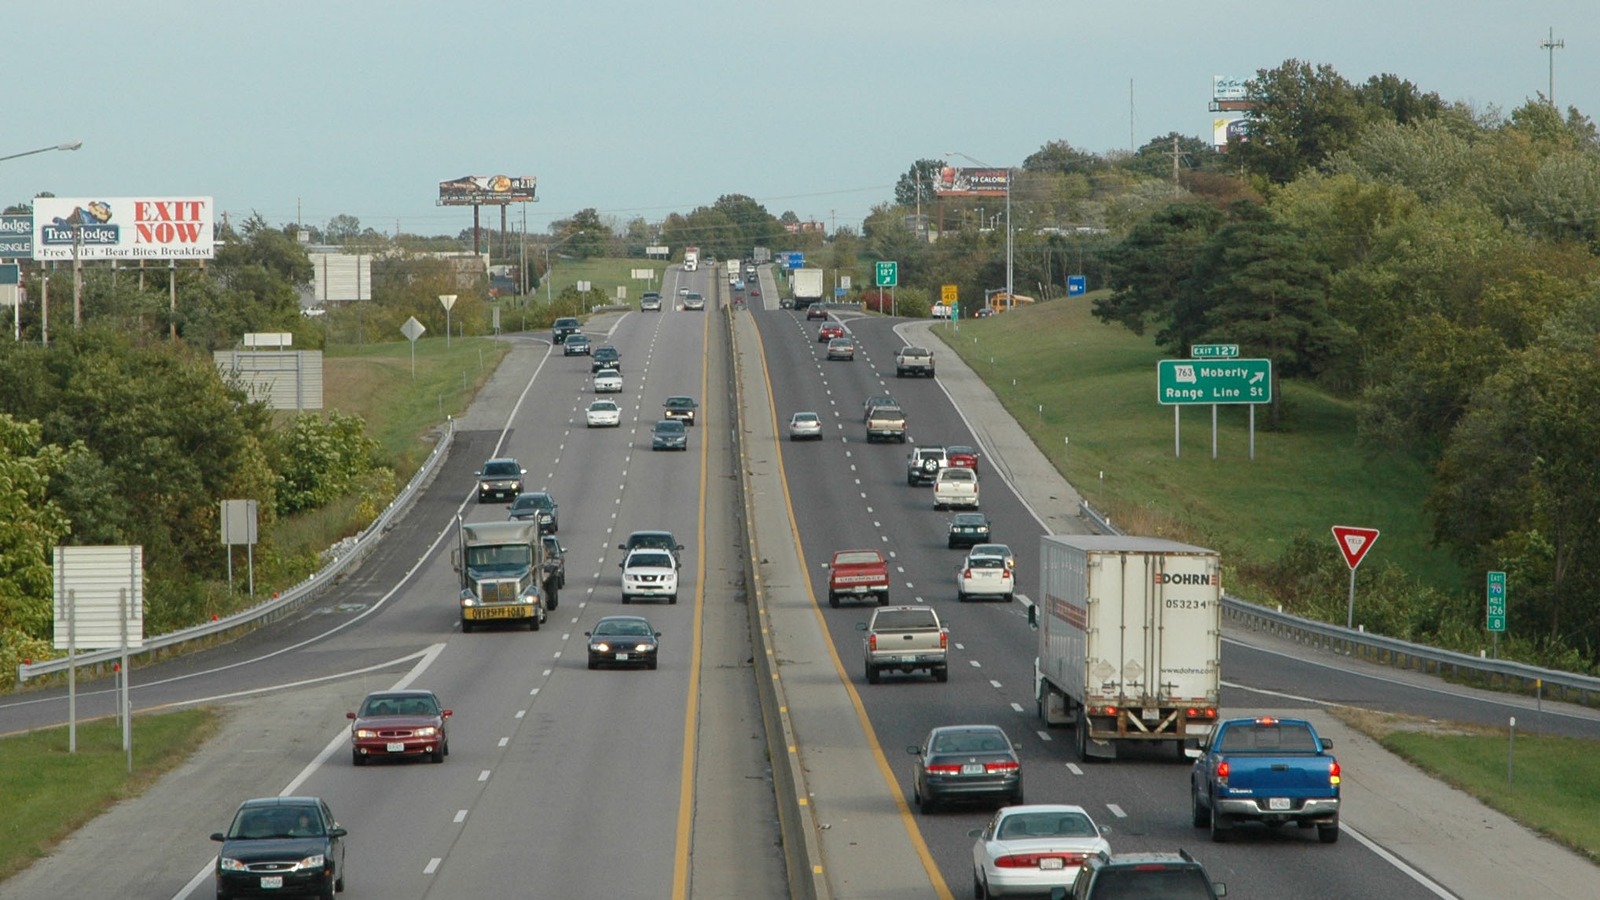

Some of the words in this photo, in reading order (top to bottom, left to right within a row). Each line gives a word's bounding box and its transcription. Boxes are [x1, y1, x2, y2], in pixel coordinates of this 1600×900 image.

[134, 201, 205, 222] EXIT
[134, 223, 204, 244] NOW
[132, 248, 157, 256] Bites
[161, 247, 210, 255] Breakfast
[1193, 347, 1212, 355] EXIT
[1215, 346, 1236, 355] 127
[1178, 368, 1192, 377] 763
[1201, 368, 1248, 379] Moberly
[1166, 388, 1203, 400] Range
[1213, 387, 1240, 397] Line
[1250, 386, 1263, 396] St
[1163, 573, 1210, 585] DOHRN
[1492, 586, 1501, 594] 70
[1166, 599, 1206, 609] 053234
[507, 606, 526, 618] LOAD
[1490, 605, 1503, 615] 126
